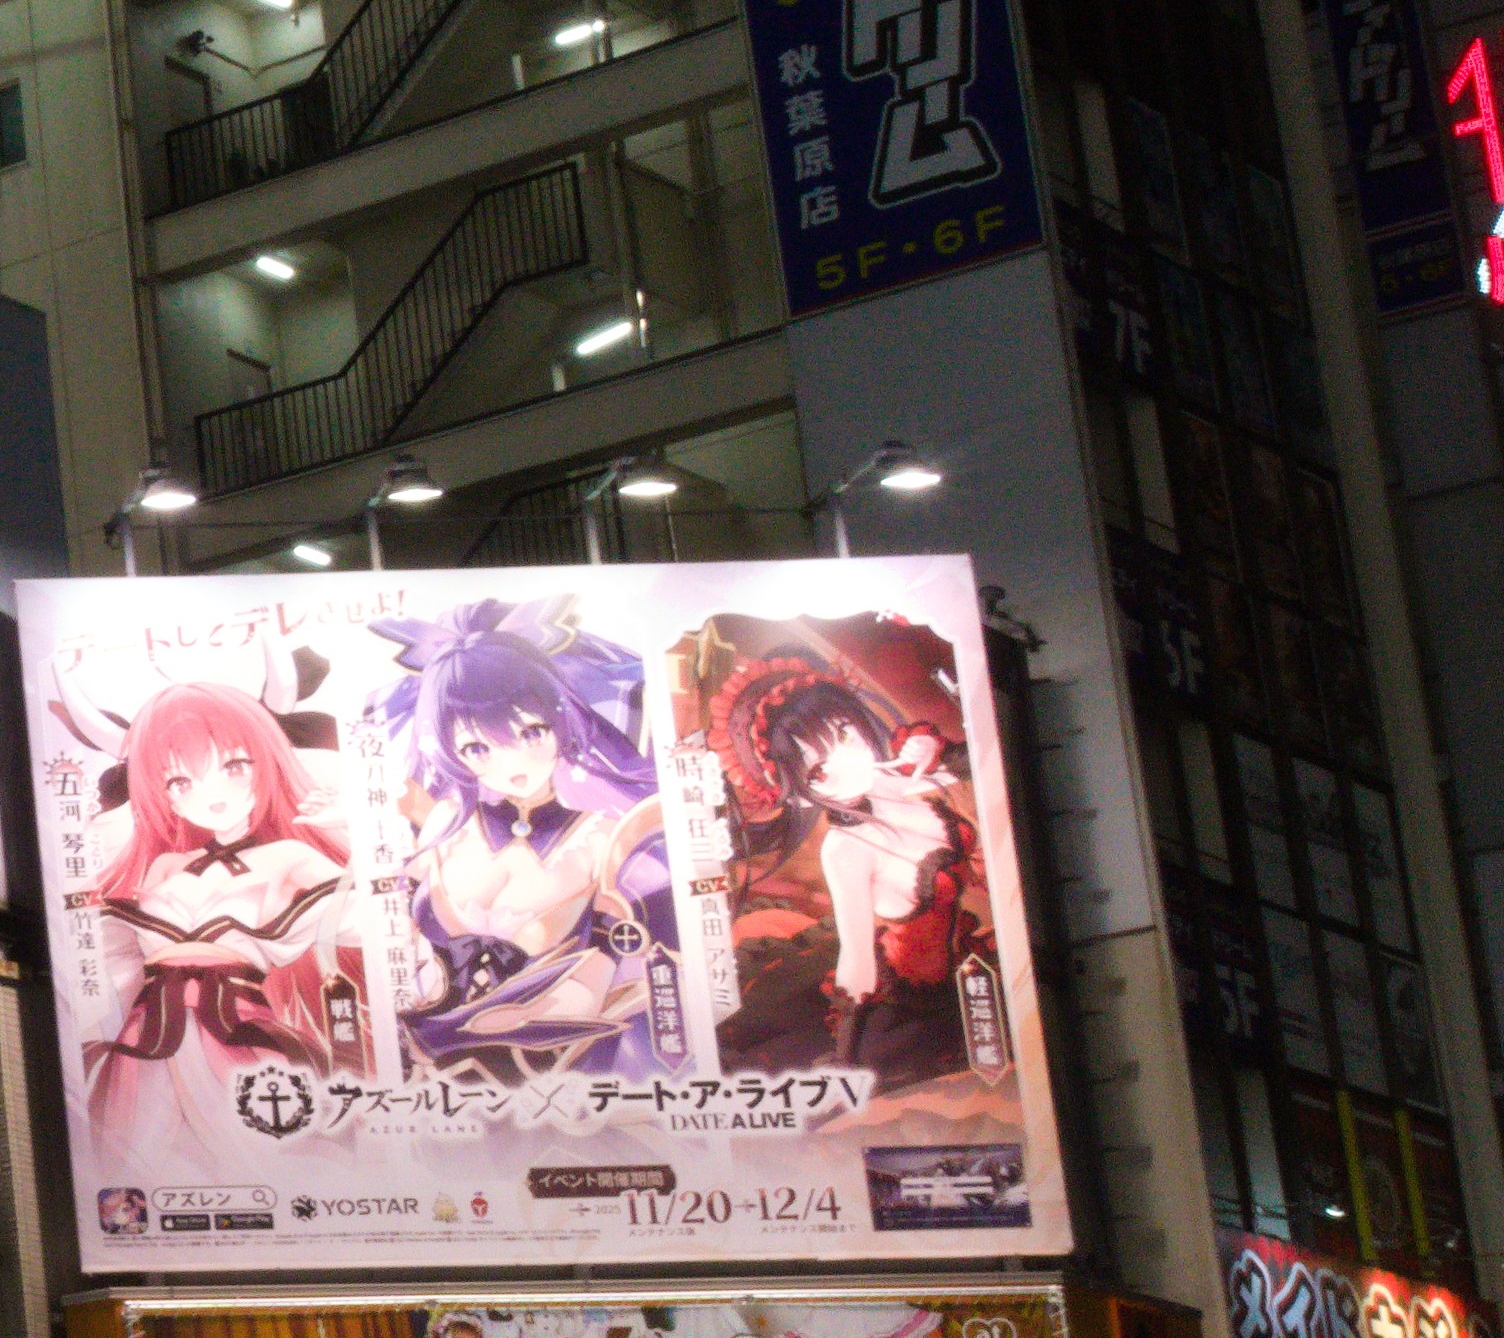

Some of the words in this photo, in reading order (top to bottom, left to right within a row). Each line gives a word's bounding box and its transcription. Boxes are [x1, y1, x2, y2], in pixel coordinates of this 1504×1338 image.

[778, 45, 840, 230] 秋葉原店
[54, 770, 89, 879] 五河琴里
[328, 996, 356, 1045] 戦艦
[651, 963, 682, 1054] 重巡洋艦
[964, 971, 1000, 1066] 軽巡洋艦
[328, 1078, 511, 1128] アズールレーン
[162, 1191, 232, 1207] アズレン
[536, 1170, 666, 1191] イベント開催期間
[322, 1197, 419, 1217] YOSTAR
[624, 1188, 733, 1227] 11/20
[756, 1186, 842, 1223] 12/4
